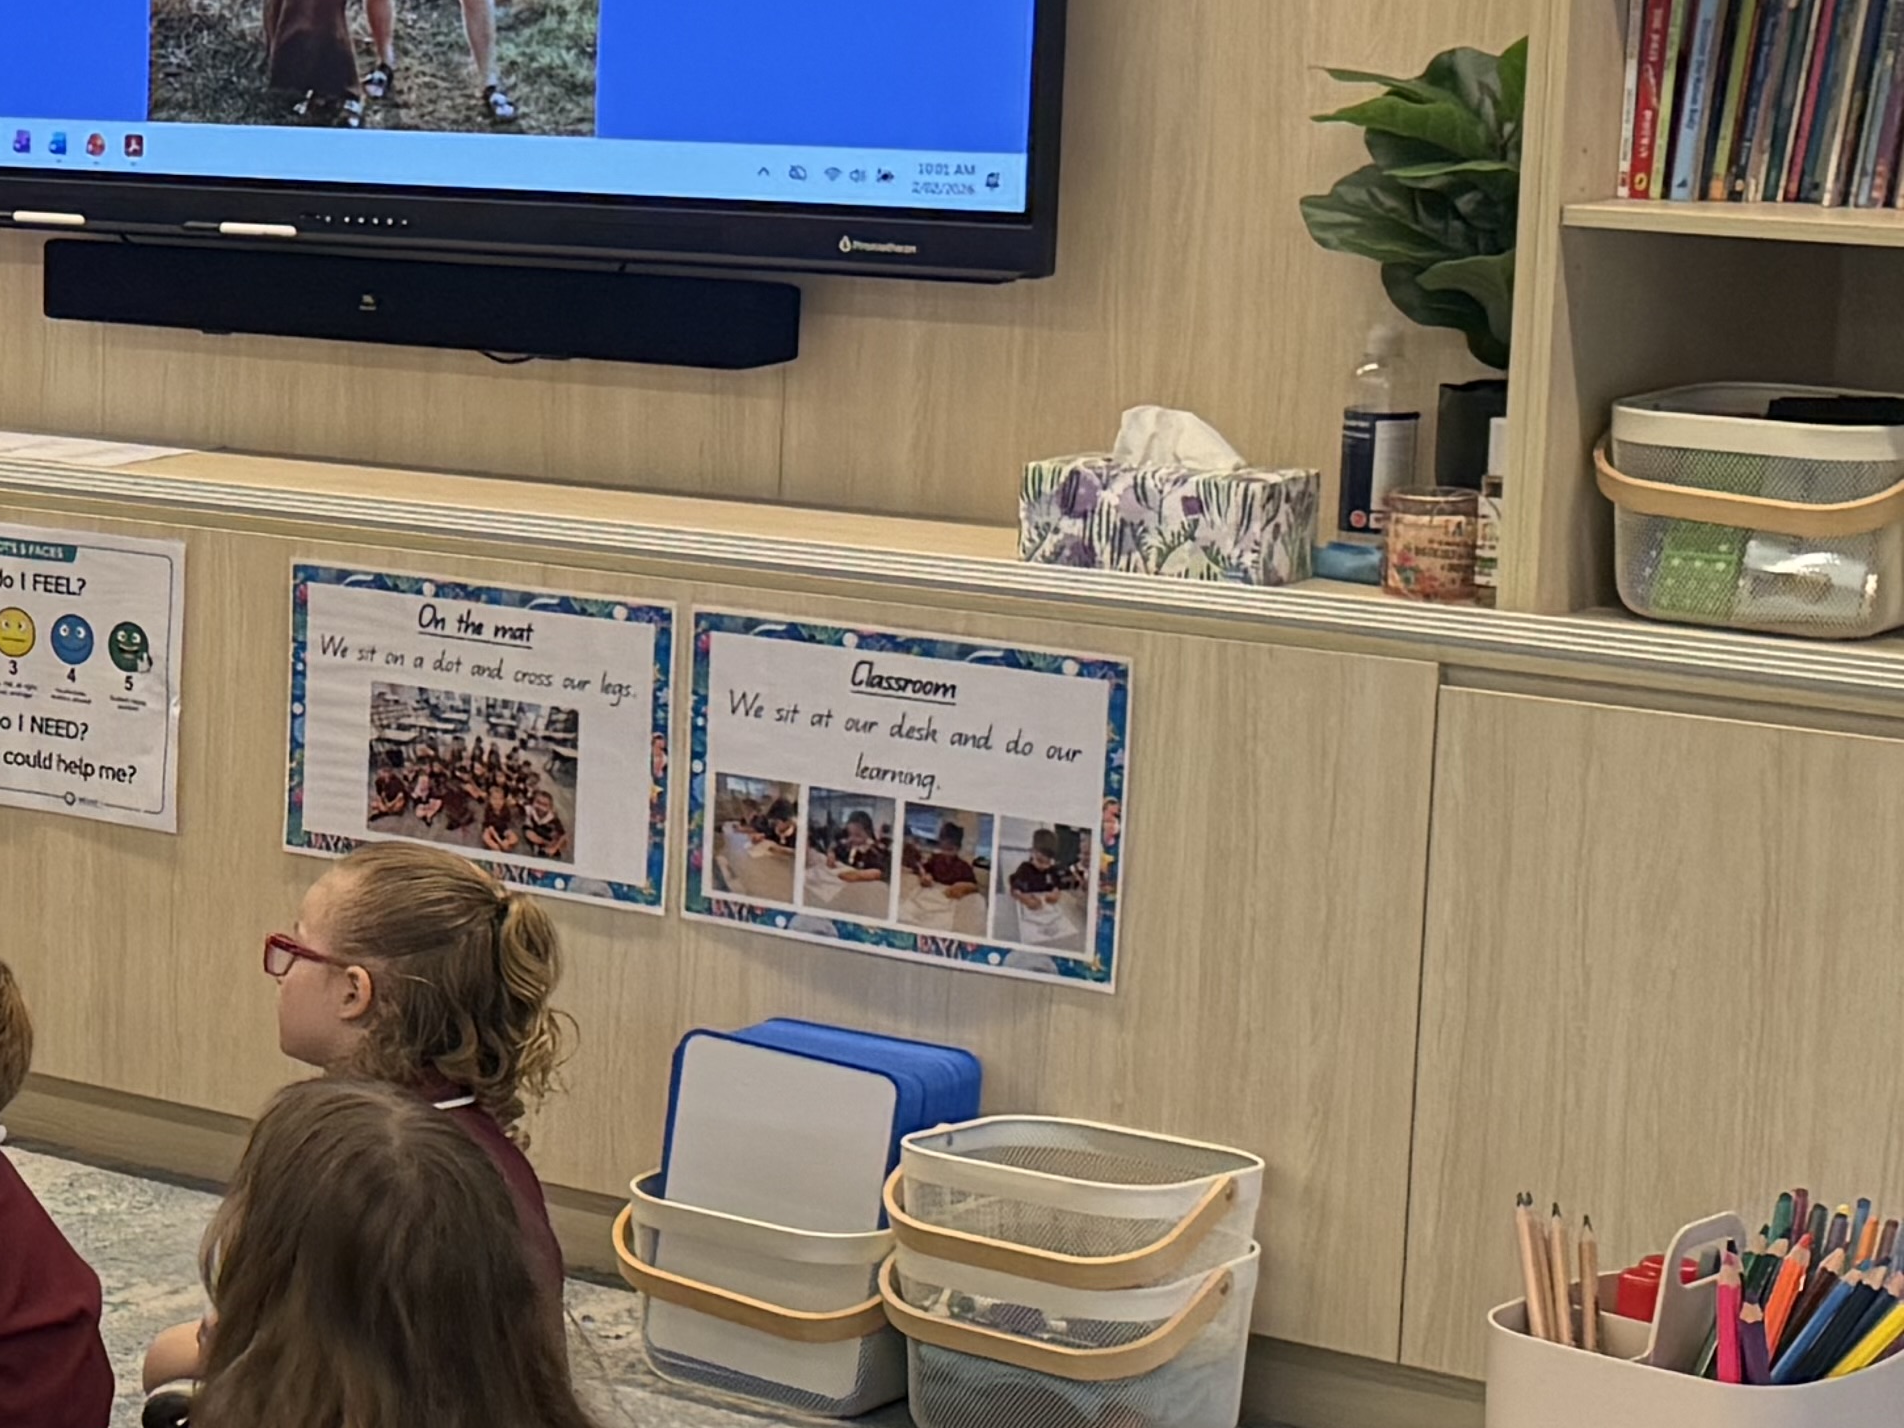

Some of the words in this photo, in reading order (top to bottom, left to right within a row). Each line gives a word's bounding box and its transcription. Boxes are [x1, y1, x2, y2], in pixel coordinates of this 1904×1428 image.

[918, 162, 951, 177] 10:01
[953, 164, 976, 177] AM
[32, 573, 87, 597] FEEL?
[417, 602, 446, 632] On
[457, 608, 484, 637] the
[494, 619, 535, 644] mat
[9, 659, 18, 676] 3
[66, 667, 77, 684] 4
[320, 634, 348, 658] We
[357, 644, 377, 662] sit
[385, 652, 405, 666] on
[414, 656, 424, 669] a
[432, 649, 463, 674] dot
[471, 658, 504, 681] and
[514, 670, 553, 689] cross
[562, 675, 592, 691] our
[601, 671, 638, 708] legs.
[850, 659, 957, 700] Classroom
[124, 675, 134, 692] 5
[30, 716, 89, 741] NEED?
[728, 689, 764, 719] We
[774, 702, 800, 723] sit
[810, 706, 834, 728] at
[844, 715, 879, 735] our
[889, 712, 939, 745] desk
[949, 723, 993, 750] and
[1005, 729, 1034, 758] do
[1046, 741, 1084, 764] our
[3, 748, 53, 772] could
[56, 754, 96, 782] help
[99, 764, 138, 784] me?
[855, 752, 942, 802] learning.
